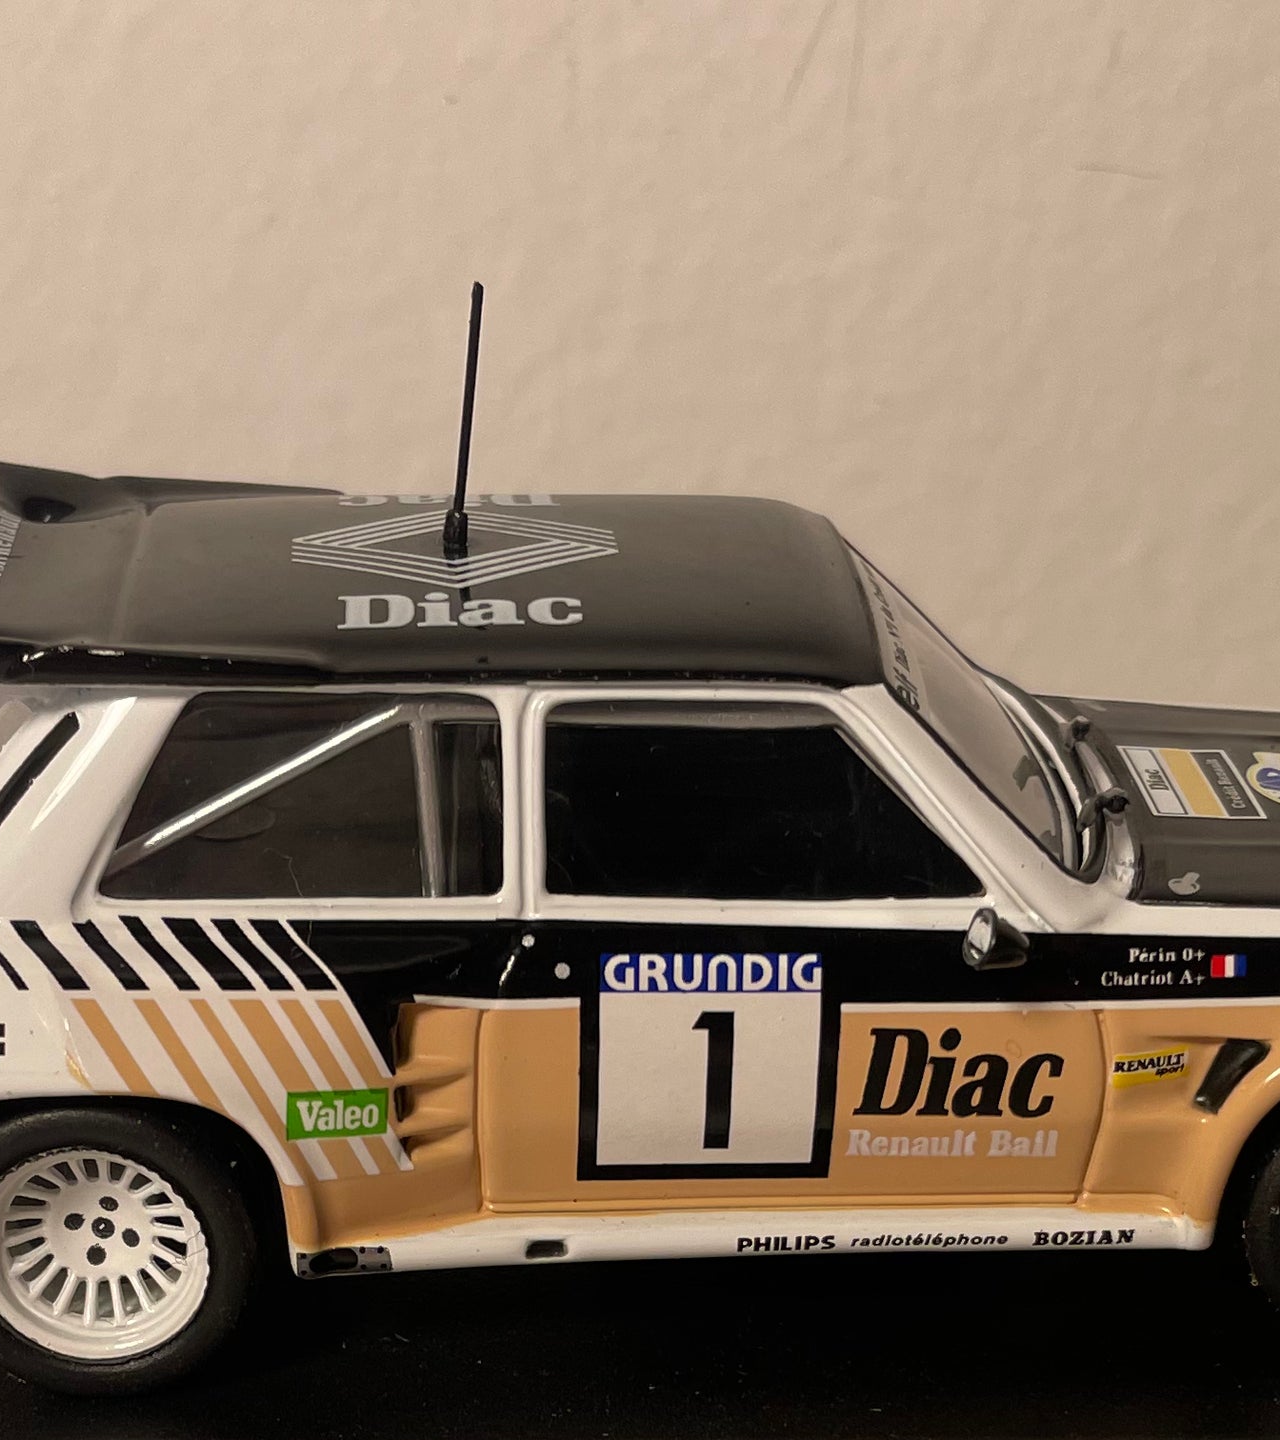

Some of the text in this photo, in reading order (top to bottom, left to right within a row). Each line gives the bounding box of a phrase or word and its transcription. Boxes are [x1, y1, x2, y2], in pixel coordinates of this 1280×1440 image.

[337, 592, 583, 630] Diac
[1144, 768, 1170, 792] Diac
[1129, 948, 1176, 963] Périn
[603, 954, 821, 992] GRUNDIG
[1101, 969, 1206, 986] Chatriot A+
[852, 1027, 1065, 1118] Diac
[1113, 1053, 1184, 1073] RENAULT
[691, 1011, 735, 1149] 1
[296, 1100, 380, 1132] Valeo
[845, 1129, 1058, 1157] Renault Bail
[737, 1229, 1135, 1252] PHILIPS radiotéléphone BOZIAN
